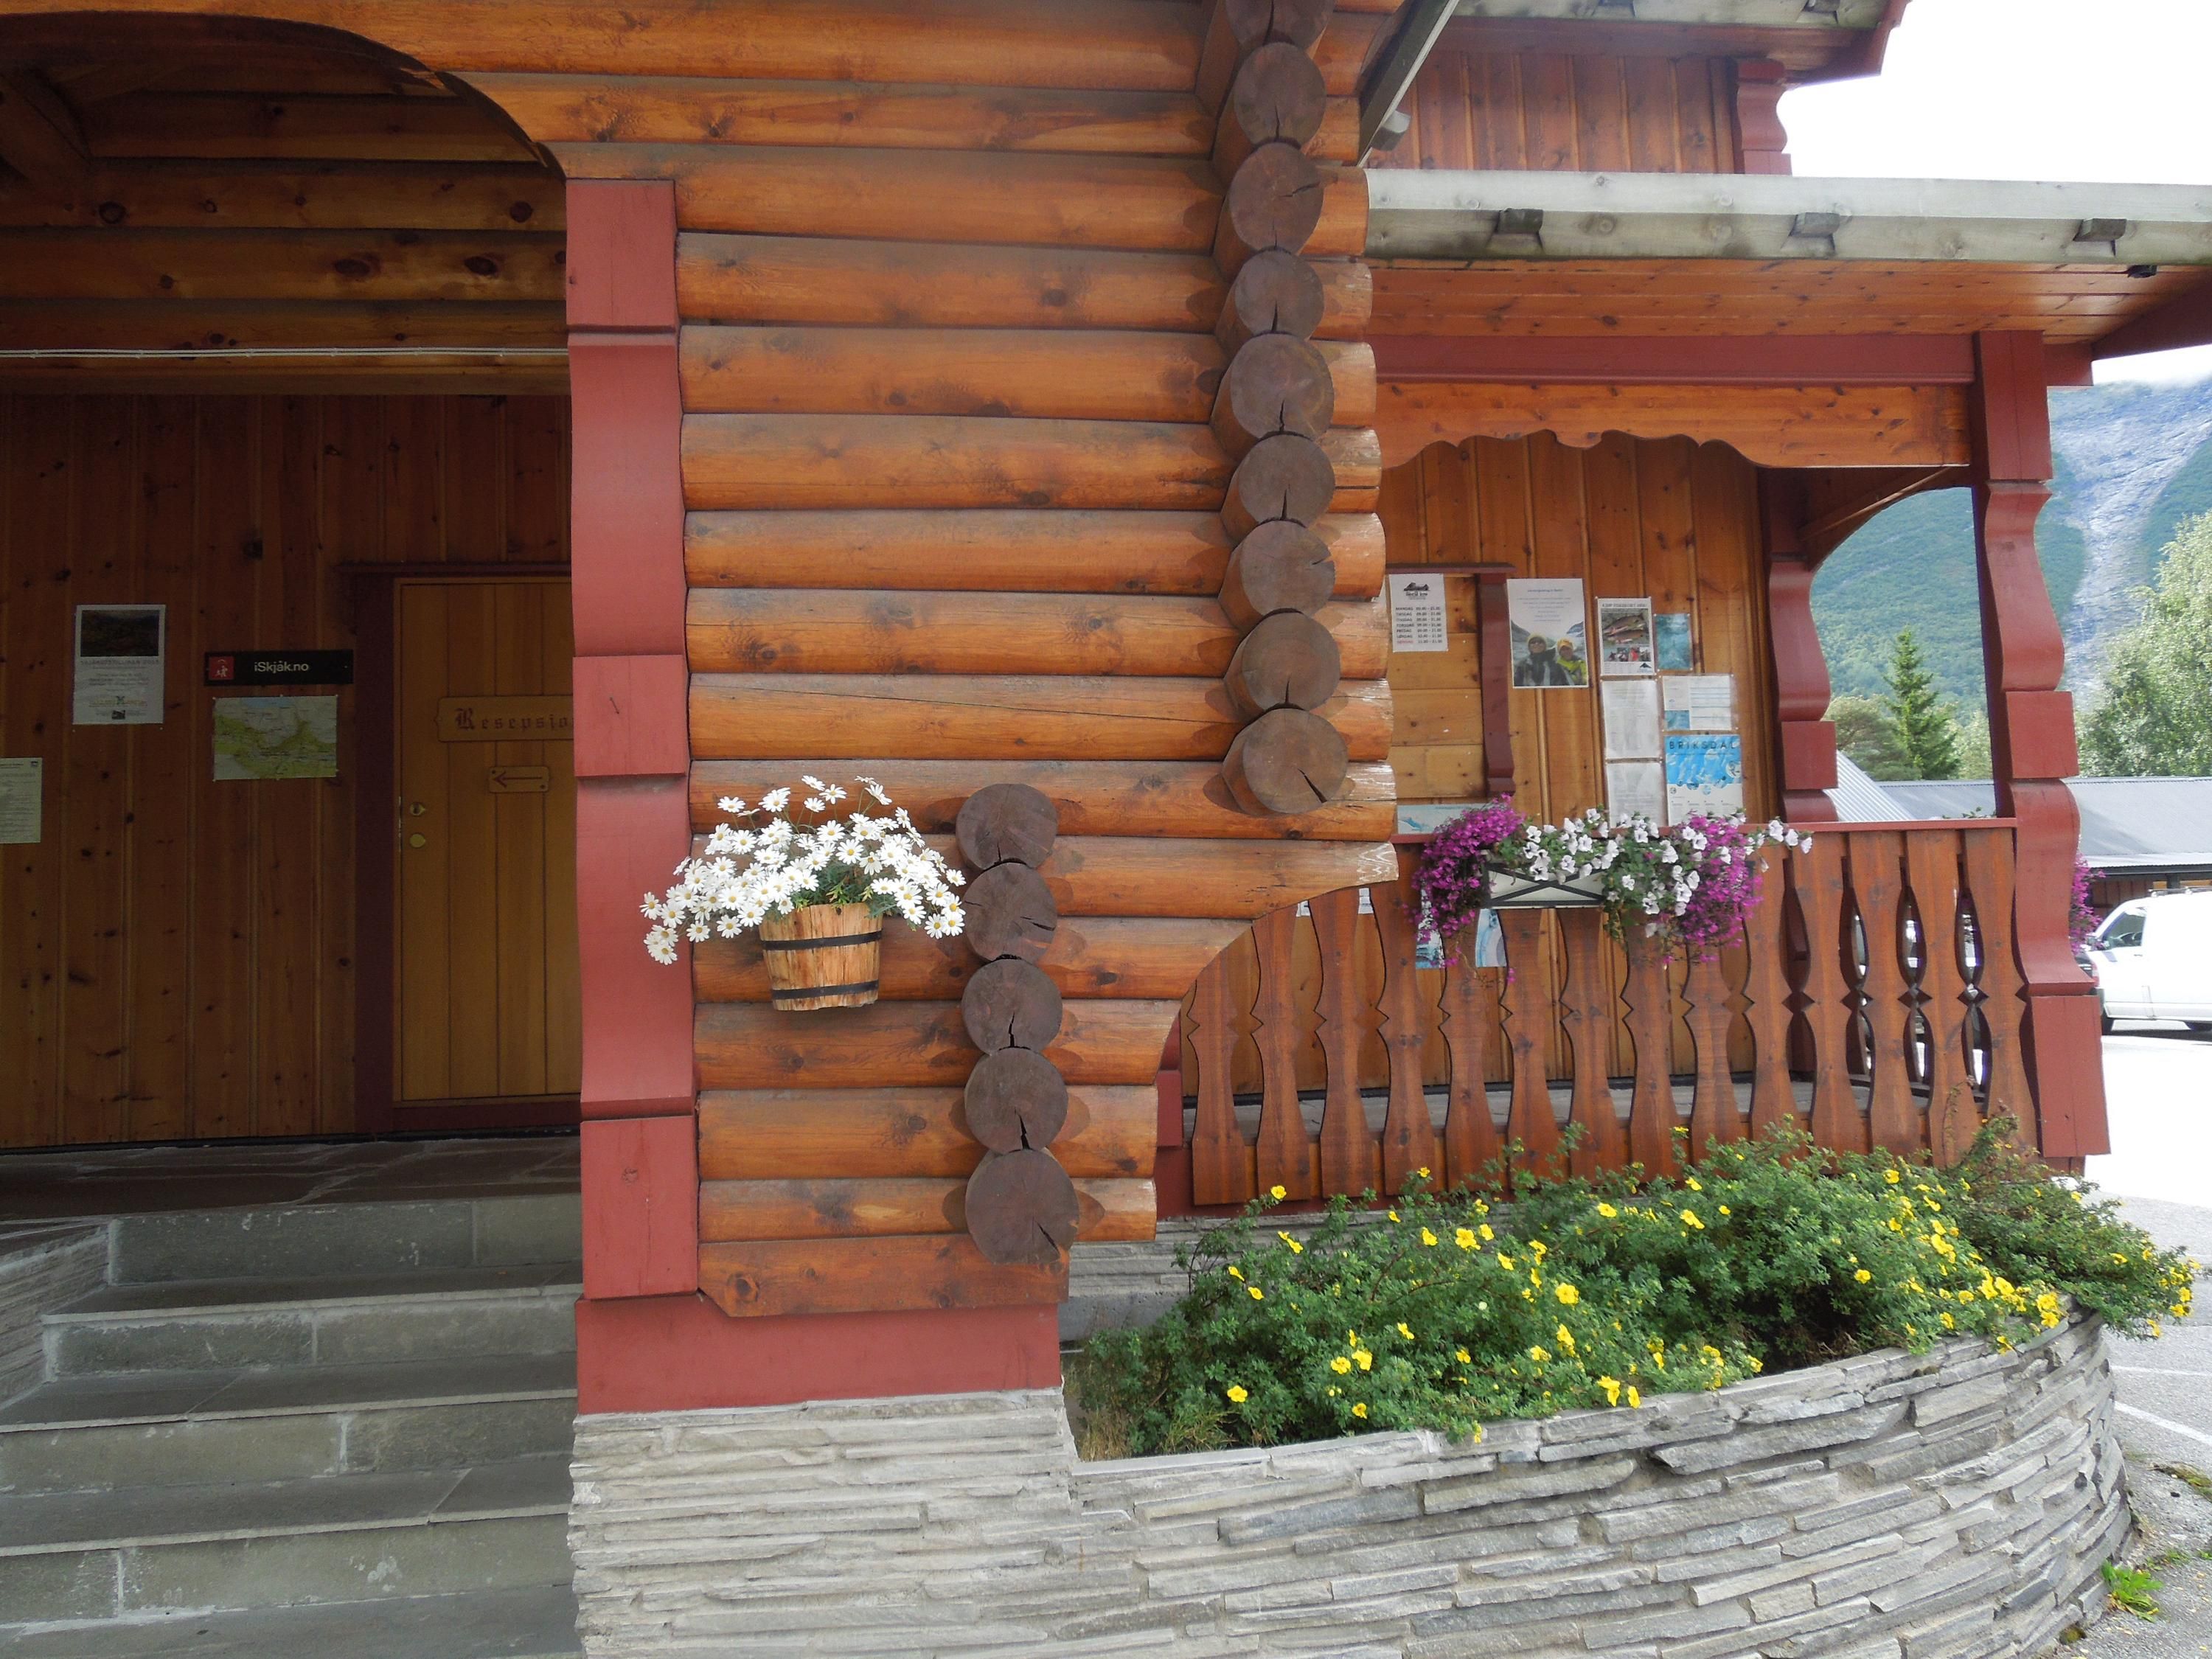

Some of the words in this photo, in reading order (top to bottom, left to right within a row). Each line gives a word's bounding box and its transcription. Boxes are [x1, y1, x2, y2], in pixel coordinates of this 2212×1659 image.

[254, 661, 309, 674] iSkjåk.no
[454, 707, 574, 732] Resepsio
[1669, 740, 1735, 750] BRIKSDAL
